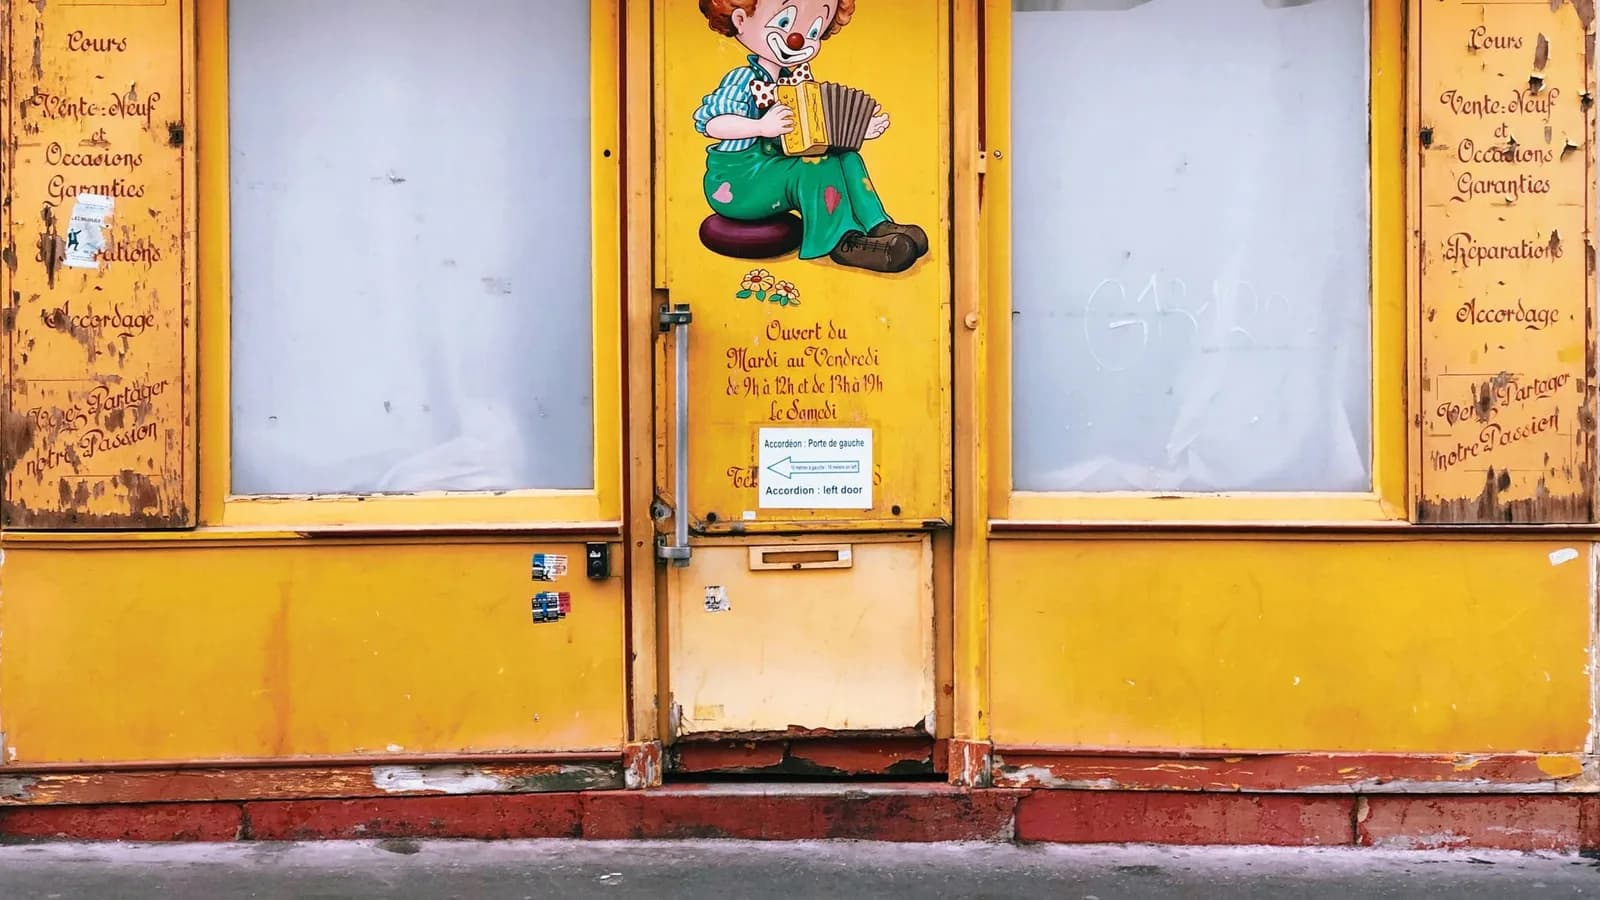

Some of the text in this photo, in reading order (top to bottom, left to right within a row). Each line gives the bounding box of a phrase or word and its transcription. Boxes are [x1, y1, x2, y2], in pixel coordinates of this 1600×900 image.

[67, 30, 127, 52] Cours
[1469, 25, 1523, 51] Cours
[91, 128, 106, 142] et
[1494, 122, 1508, 138] et
[46, 141, 143, 172] Occasions
[1458, 138, 1553, 166] Occasions
[47, 174, 145, 203] Garanties
[1455, 171, 1551, 201] Garanties
[1446, 232, 1564, 268] Réparations
[40, 300, 155, 337] Accordage
[1456, 298, 1559, 331] Accordage
[766, 319, 847, 341] Ouvert du
[726, 346, 879, 372] Mardi au Vendredi
[86, 379, 168, 415] Partager
[726, 376, 738, 396] de
[743, 376, 759, 398] 9h
[763, 379, 770, 395] à
[775, 376, 794, 395] 12h
[798, 379, 808, 394] et
[812, 373, 824, 394] de
[830, 374, 850, 393] 13h
[864, 373, 883, 396] 19h
[1496, 373, 1571, 406] Partager
[769, 398, 838, 422] Le Samedi
[27, 422, 157, 477] notre Passion
[764, 438, 802, 449] Accordéon
[808, 438, 827, 448] Porte
[829, 438, 837, 448] de
[839, 438, 865, 449] gauche
[1438, 412, 1559, 472] notre Passion
[765, 485, 814, 496] Accordion
[823, 485, 838, 495] left
[841, 485, 863, 495] door
